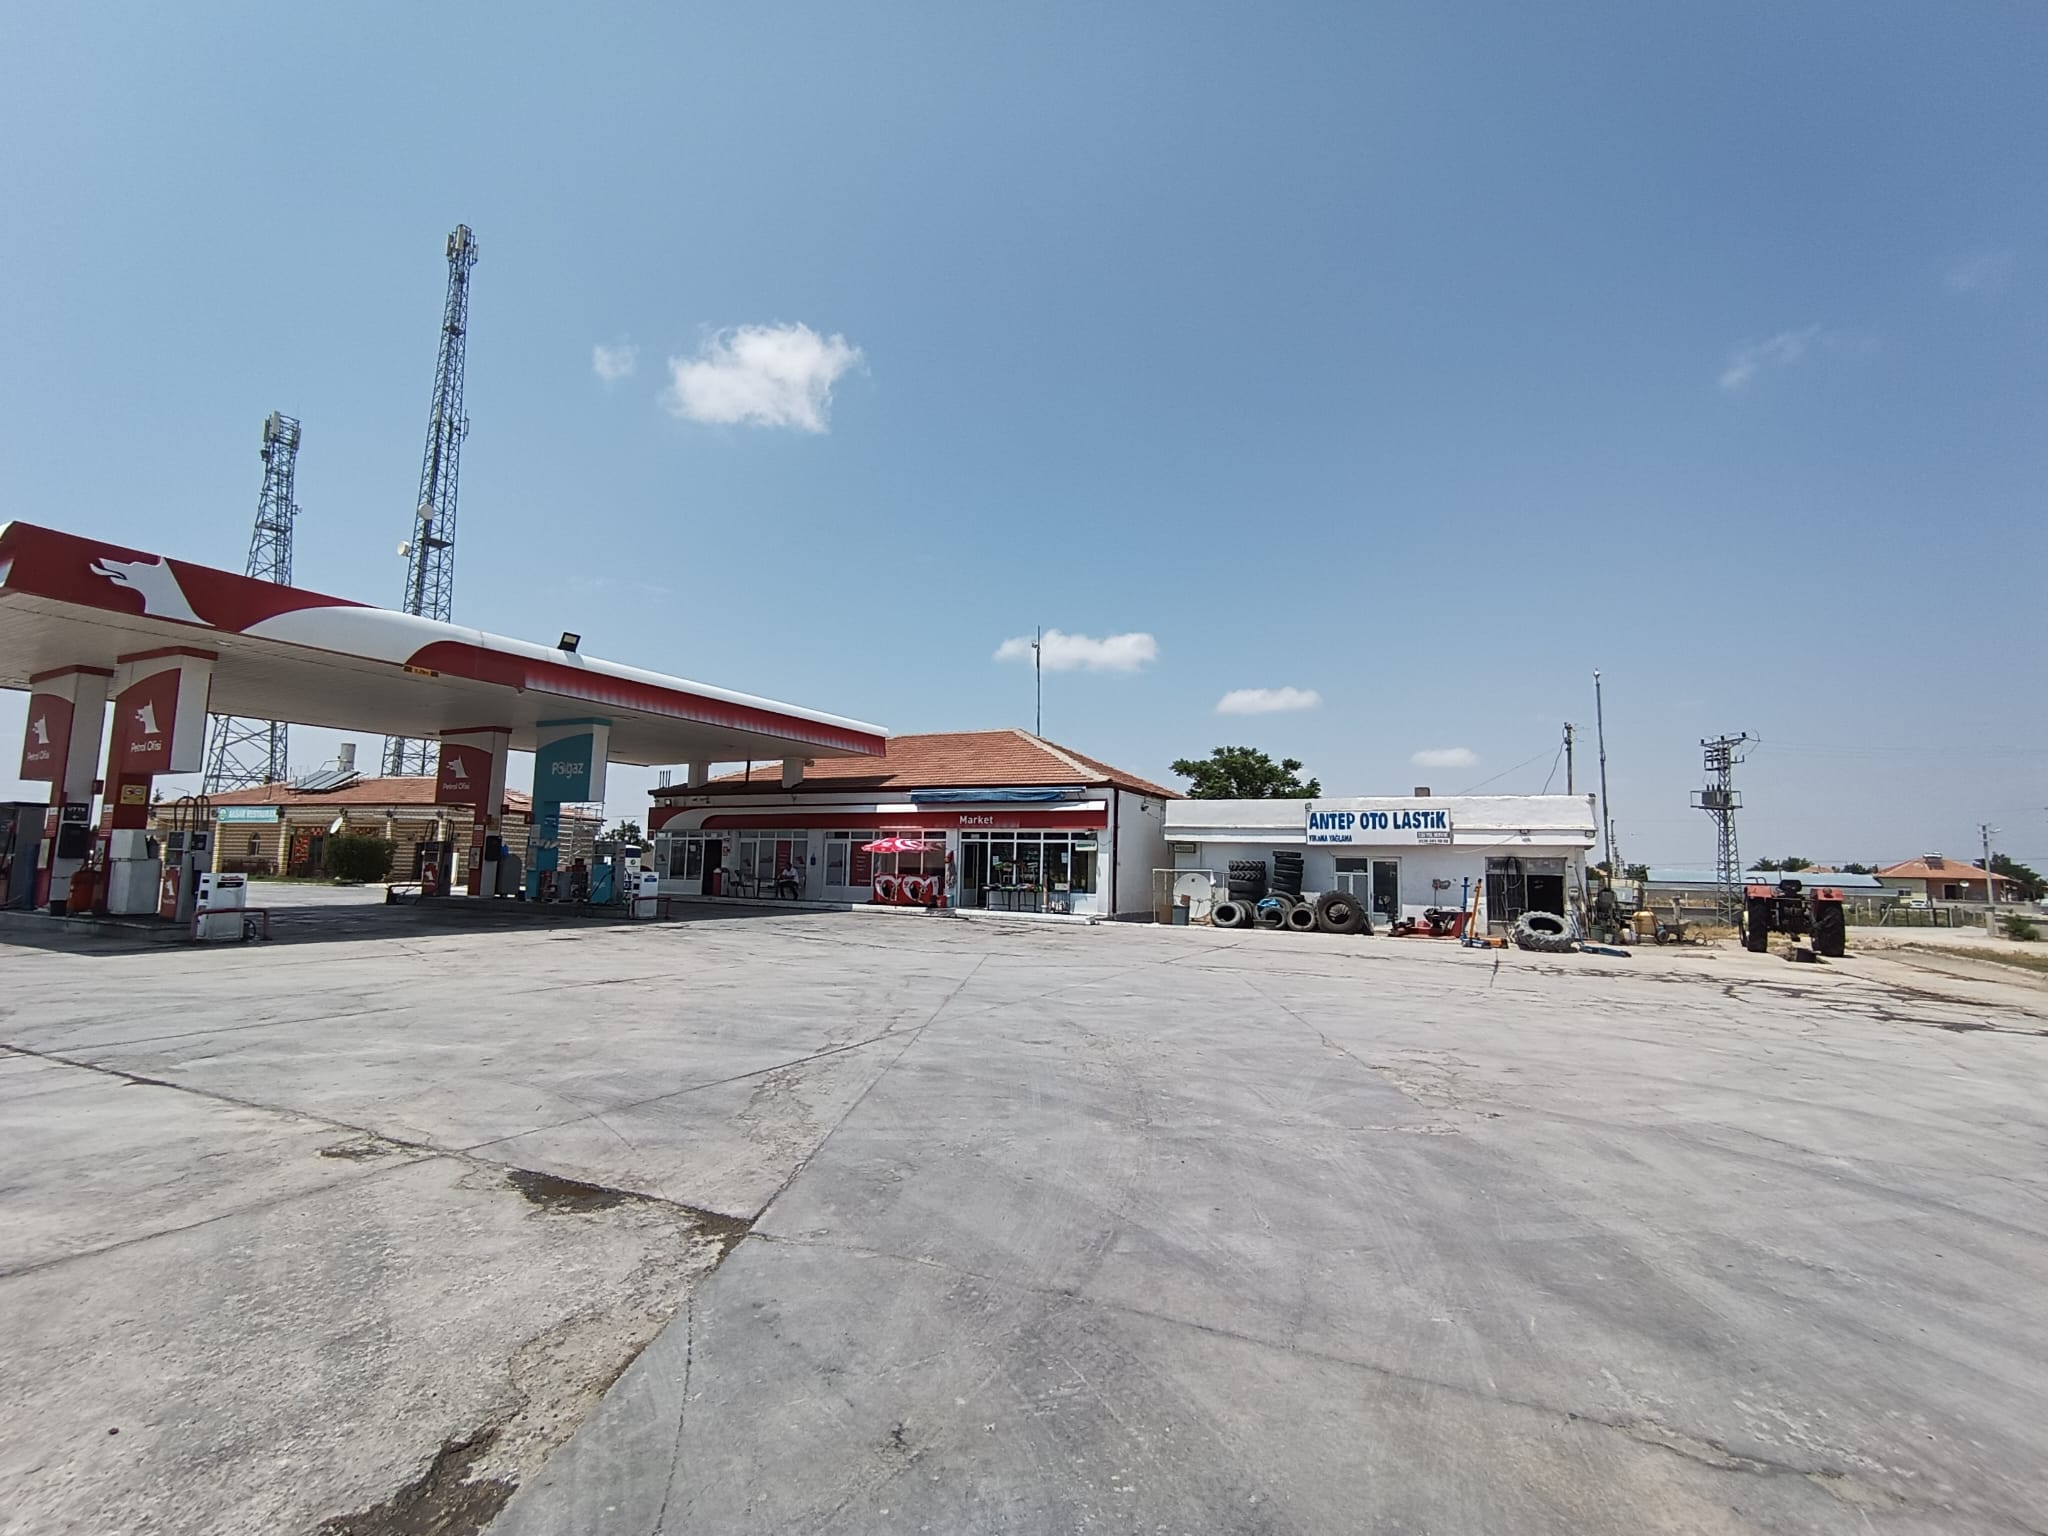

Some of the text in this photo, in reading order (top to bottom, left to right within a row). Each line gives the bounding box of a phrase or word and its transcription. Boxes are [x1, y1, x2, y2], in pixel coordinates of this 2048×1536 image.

[959, 815, 993, 825] Market
[1309, 812, 1355, 830] ANTEP
[1360, 812, 1388, 830] OTO
